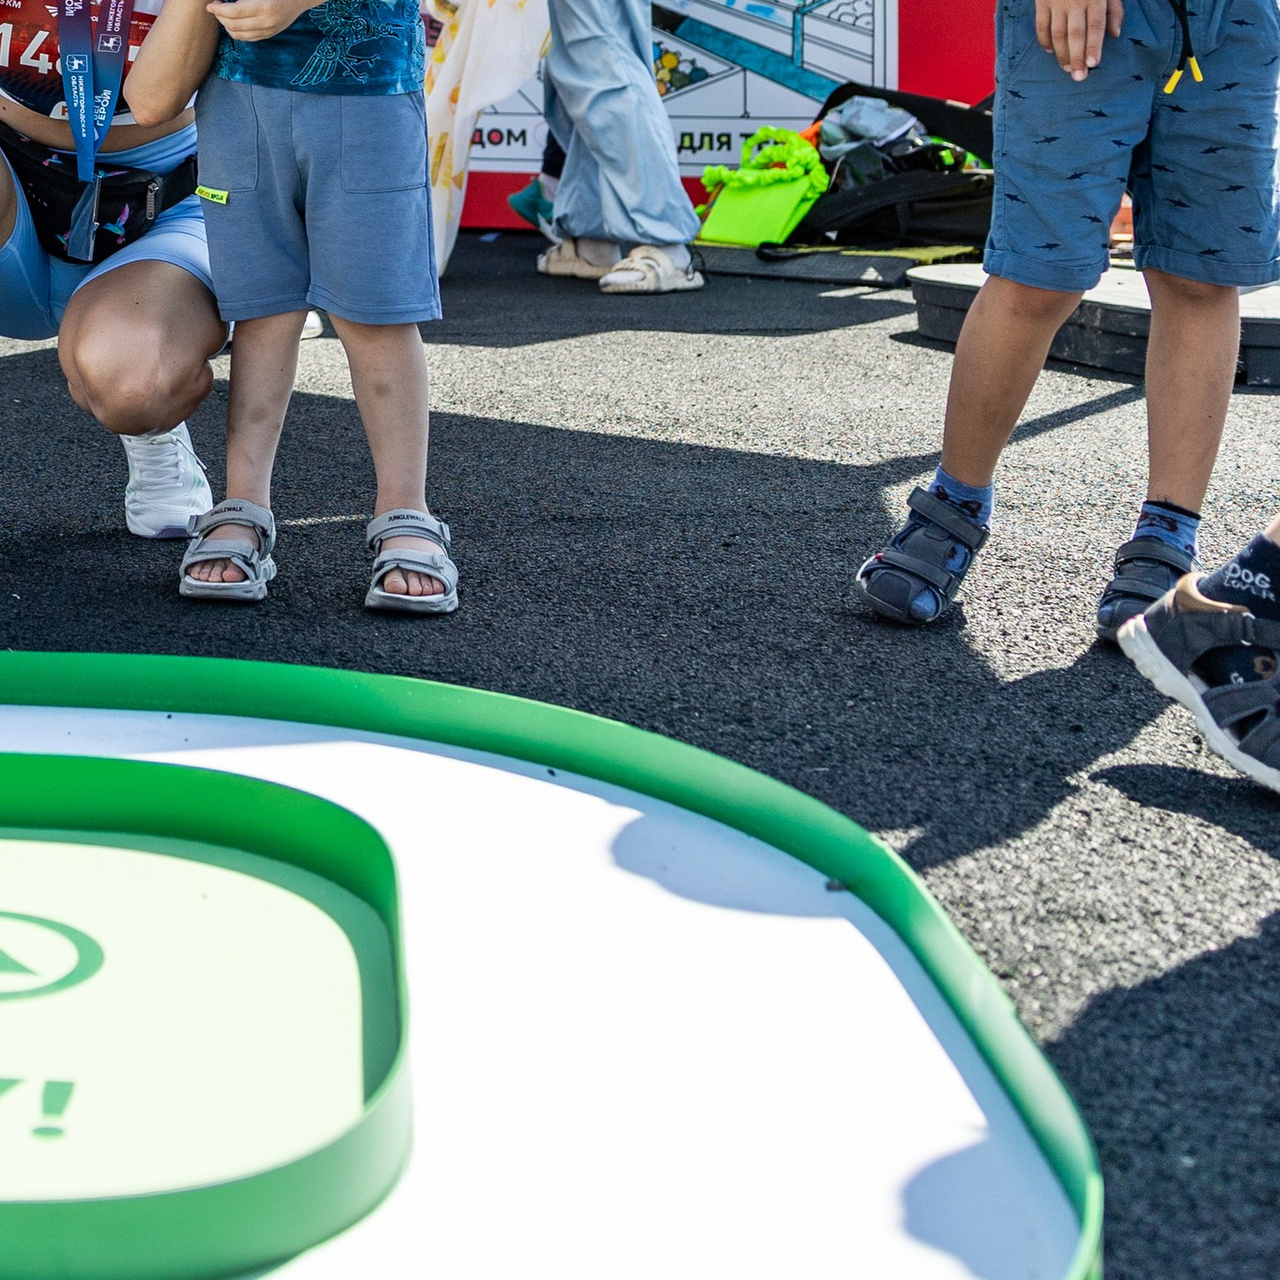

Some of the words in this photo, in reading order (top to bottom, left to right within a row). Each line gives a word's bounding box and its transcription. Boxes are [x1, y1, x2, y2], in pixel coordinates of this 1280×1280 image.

[113, 0, 125, 32] ОБЛАСТЬ
[71, 75, 79, 108] ОБЛАСТЬ
[78, 75, 87, 138] НИЖЕГОРОДСКАЯ
[96, 89, 112, 127] ГЕРОЙ!
[471, 128, 527, 149] ДОМ
[677, 132, 732, 154] ДЛЯ
[1225, 563, 1271, 589] DOG
